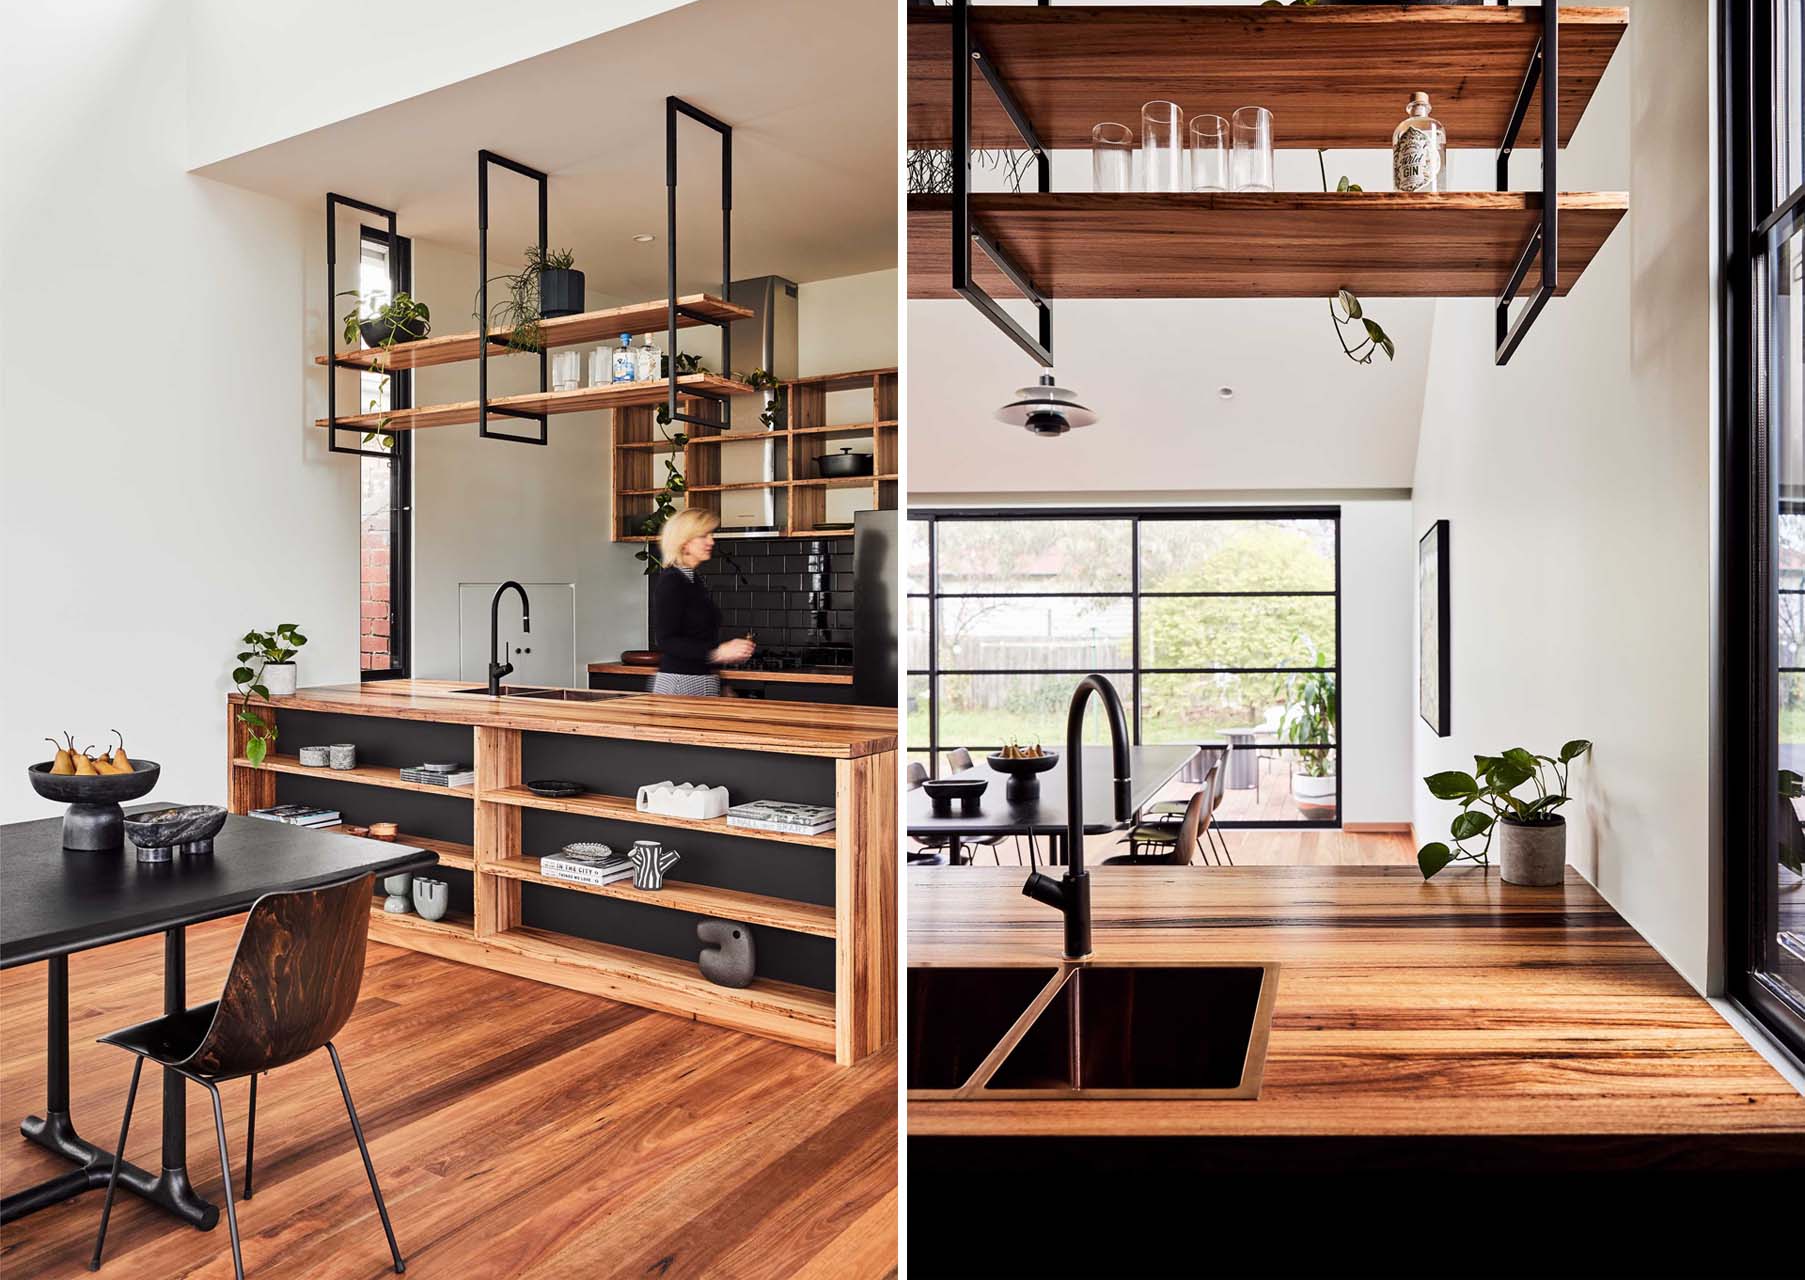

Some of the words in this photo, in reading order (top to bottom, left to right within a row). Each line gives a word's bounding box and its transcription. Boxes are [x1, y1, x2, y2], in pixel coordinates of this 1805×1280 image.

[1403, 165, 1419, 178] GIN
[565, 864, 576, 872] THE
[578, 867, 593, 875] CITY
